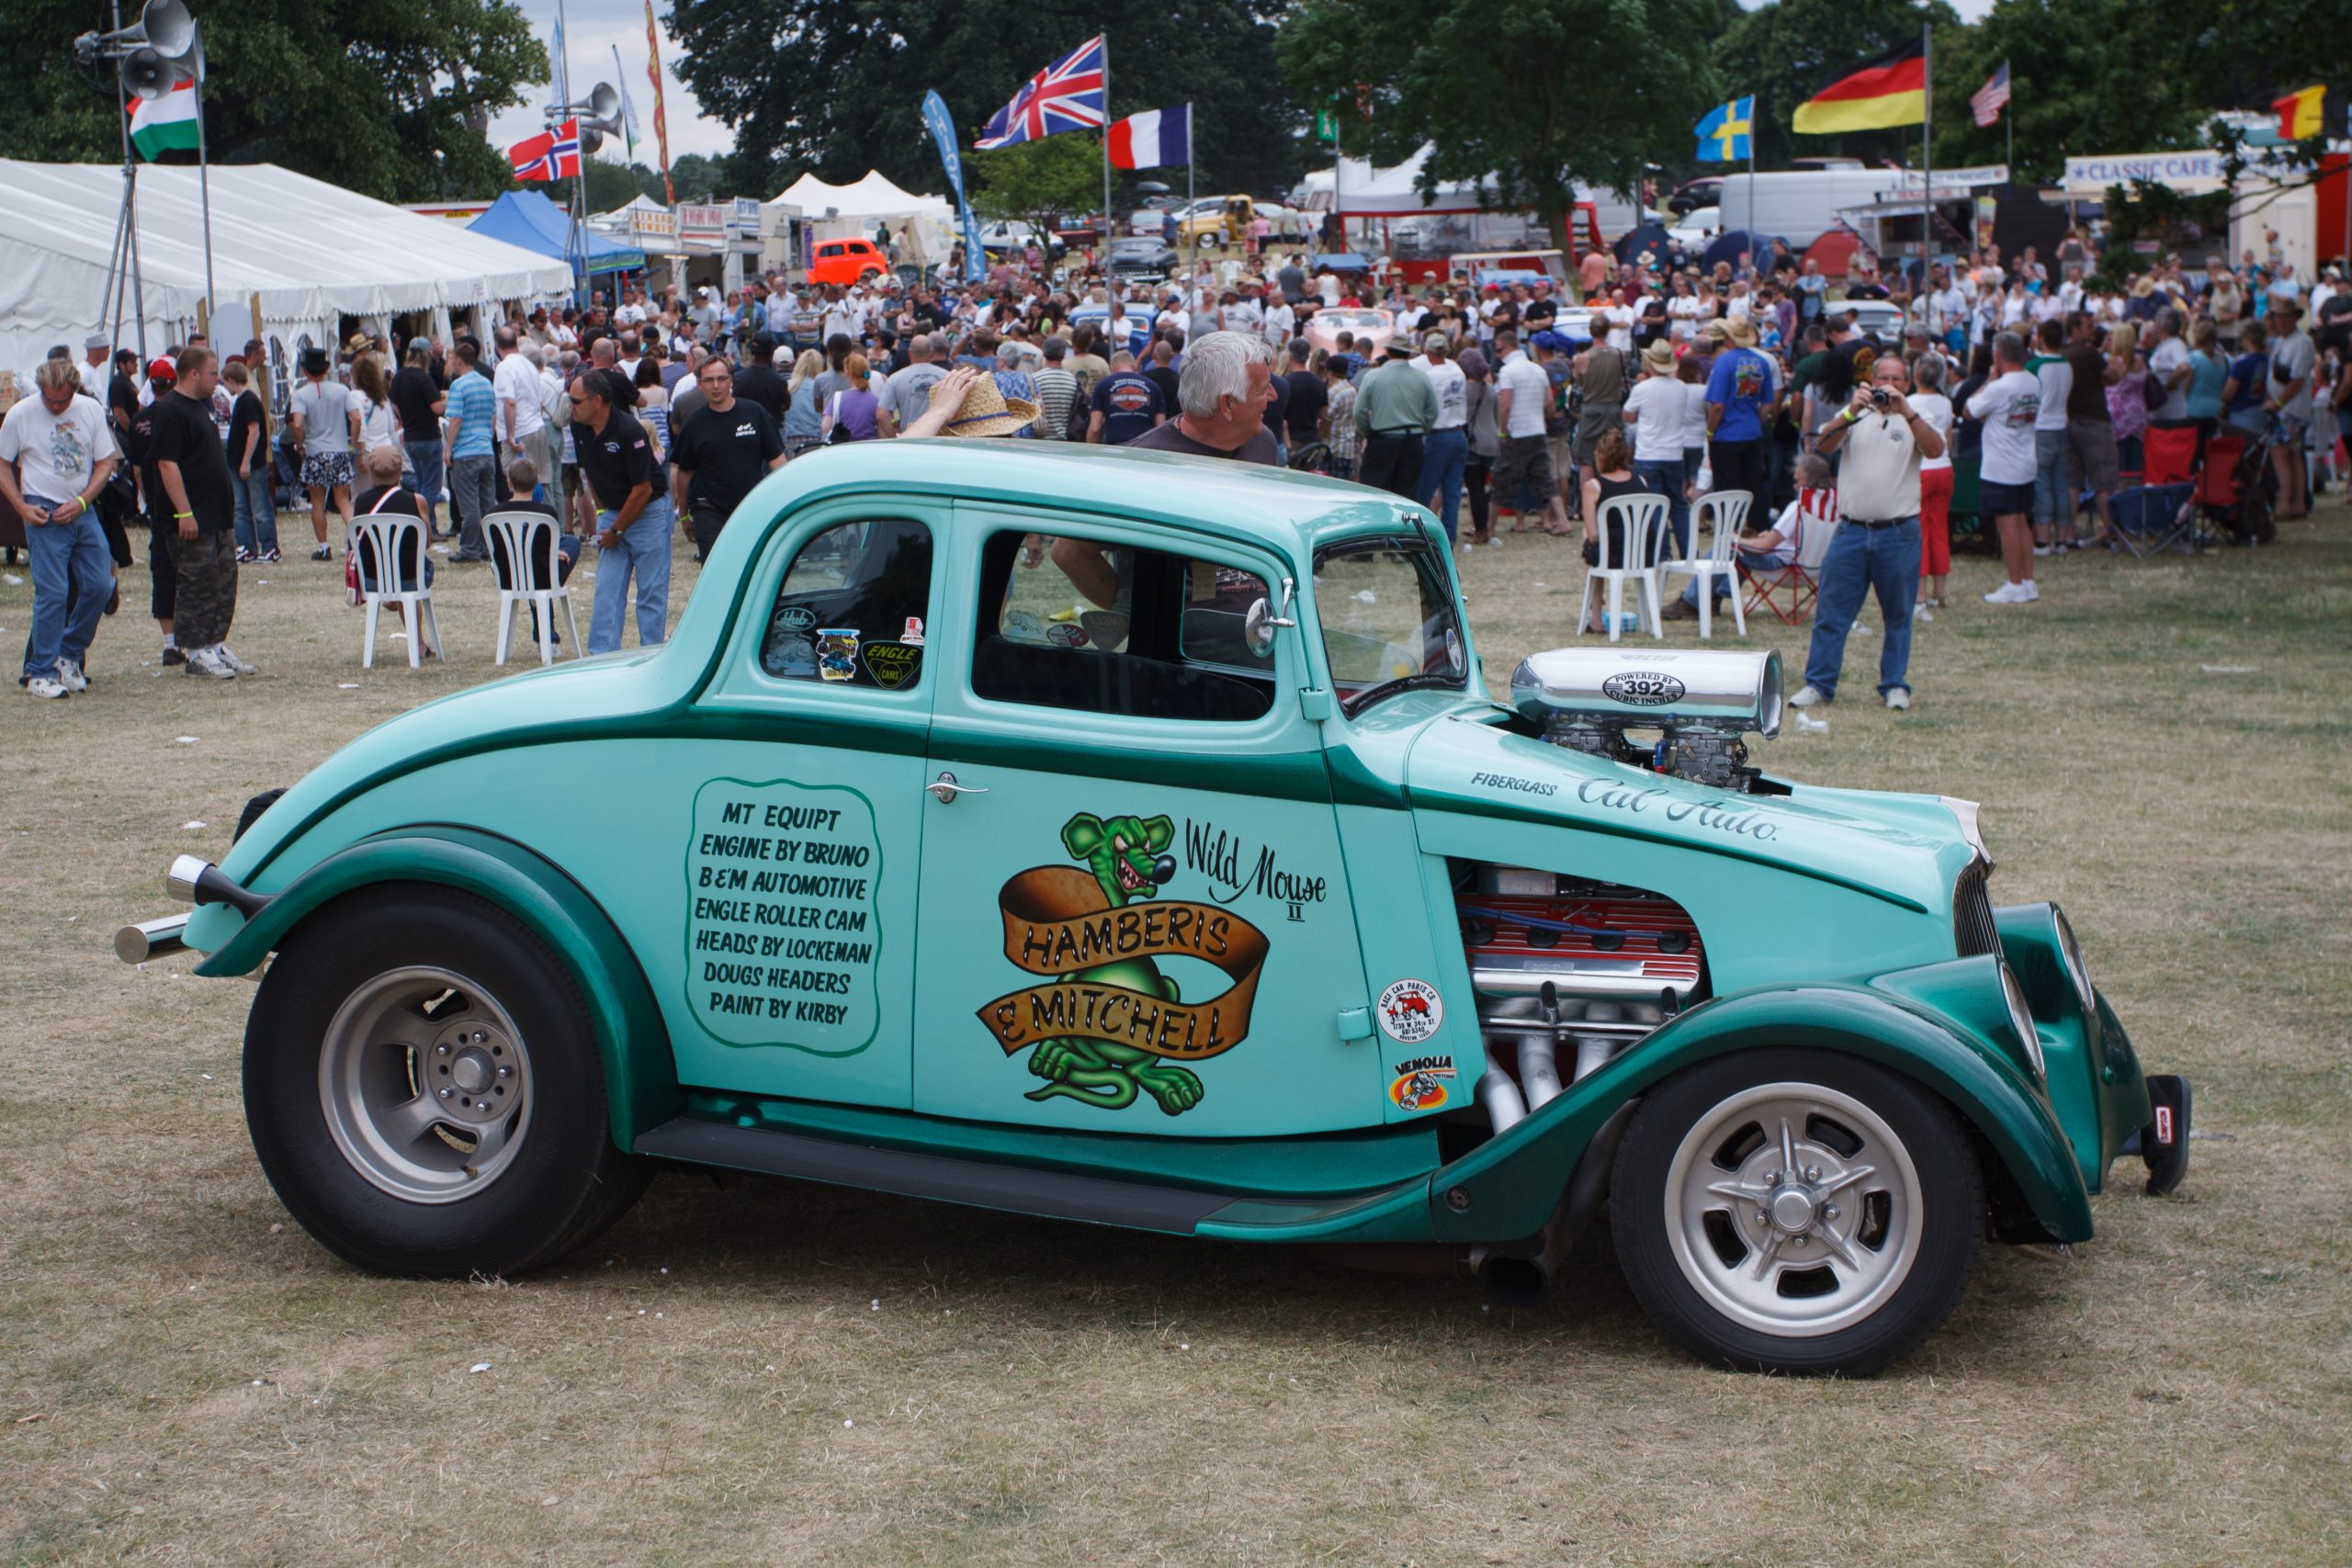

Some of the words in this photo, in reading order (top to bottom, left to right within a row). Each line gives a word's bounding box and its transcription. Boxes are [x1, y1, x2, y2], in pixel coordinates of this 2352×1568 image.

[2087, 162, 2163, 181] CLASSIC
[2165, 157, 2211, 177] CAFE
[784, 611, 809, 626] Hub
[867, 645, 919, 660] ENGLE
[881, 668, 899, 681] CAMS
[1615, 671, 1660, 682] POWERED
[1662, 673, 1674, 685] BY
[1623, 681, 1665, 695] 392
[1610, 690, 1640, 705] CUBIC
[1641, 692, 1679, 705] INCHES
[1471, 772, 1558, 796] FIBERGLASS
[1577, 777, 1668, 813] Cal
[722, 802, 756, 825] MT
[763, 805, 841, 832] EQUIPT
[699, 833, 773, 860] ENGINE
[775, 839, 802, 862] BY
[803, 840, 870, 868] BRUNO
[1185, 817, 1242, 888] Wild
[752, 871, 867, 901] AUTOMOTIVE
[1209, 843, 1327, 905] Mouse
[695, 897, 751, 923] ENGLE
[753, 903, 821, 929] ROLLER
[824, 908, 867, 932] CAM
[695, 929, 759, 955] HEADS
[761, 935, 785, 957] BY
[786, 938, 873, 964] LOCKEMAN
[1023, 906, 1230, 968] HAMBERIS
[703, 961, 763, 987] DOUGS
[766, 967, 852, 995] HEADERS
[709, 992, 764, 1016] PAINT
[768, 998, 792, 1020] BY
[795, 1001, 849, 1026] KIRBY
[1381, 993, 1393, 1008] RACE
[1391, 984, 1405, 994] CAR
[1408, 982, 1428, 993] PARTS
[1031, 987, 1226, 1053] MITCHELL
[1394, 1055, 1453, 1077] VENOLIA
